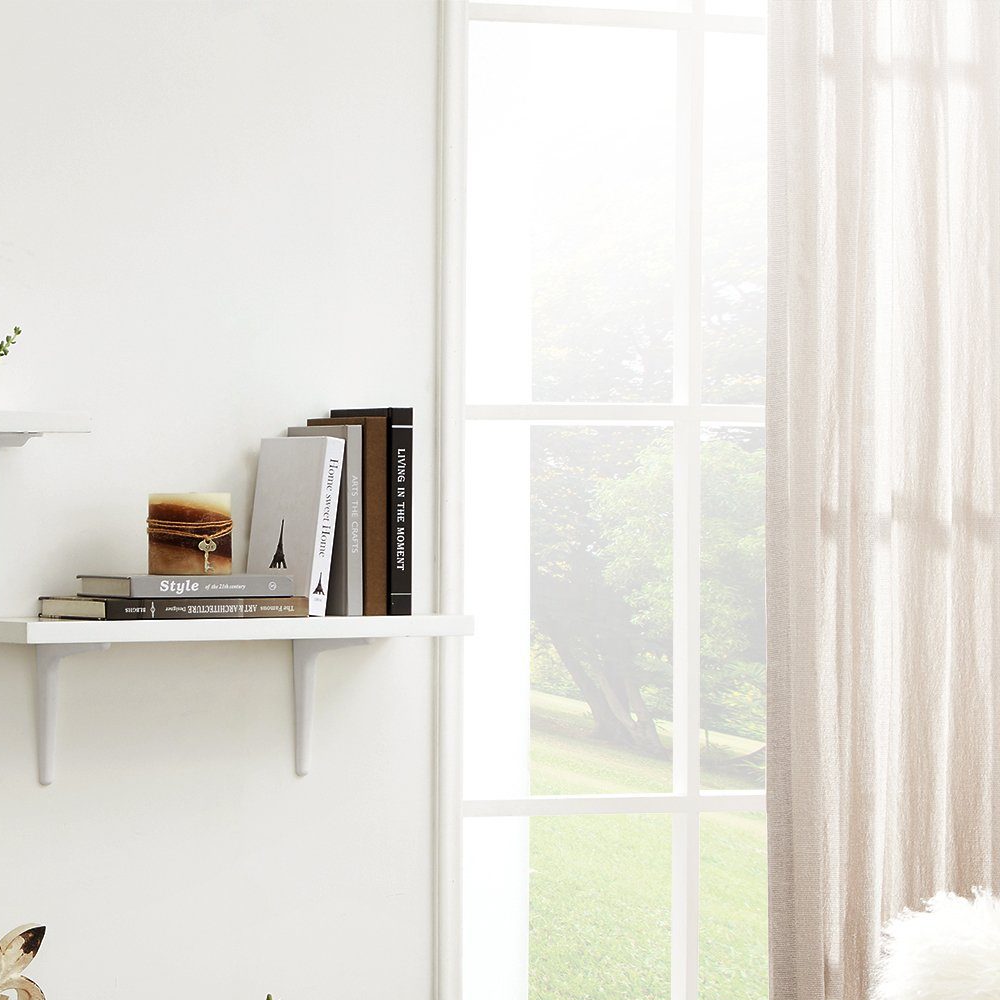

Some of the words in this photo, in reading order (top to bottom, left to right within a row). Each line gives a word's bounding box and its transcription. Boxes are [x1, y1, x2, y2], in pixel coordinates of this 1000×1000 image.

[326, 457, 339, 491] Home
[397, 449, 406, 482] LIVING
[351, 475, 359, 497] ARTS
[397, 487, 405, 497] IN
[323, 493, 332, 522] sweet
[351, 501, 359, 517] THE
[397, 502, 405, 522] THE
[319, 525, 331, 558] Home
[351, 521, 359, 554] CRAFTS
[396, 527, 405, 571] MOMENT
[159, 579, 200, 595] Style
[244, 604, 258, 613] ART
